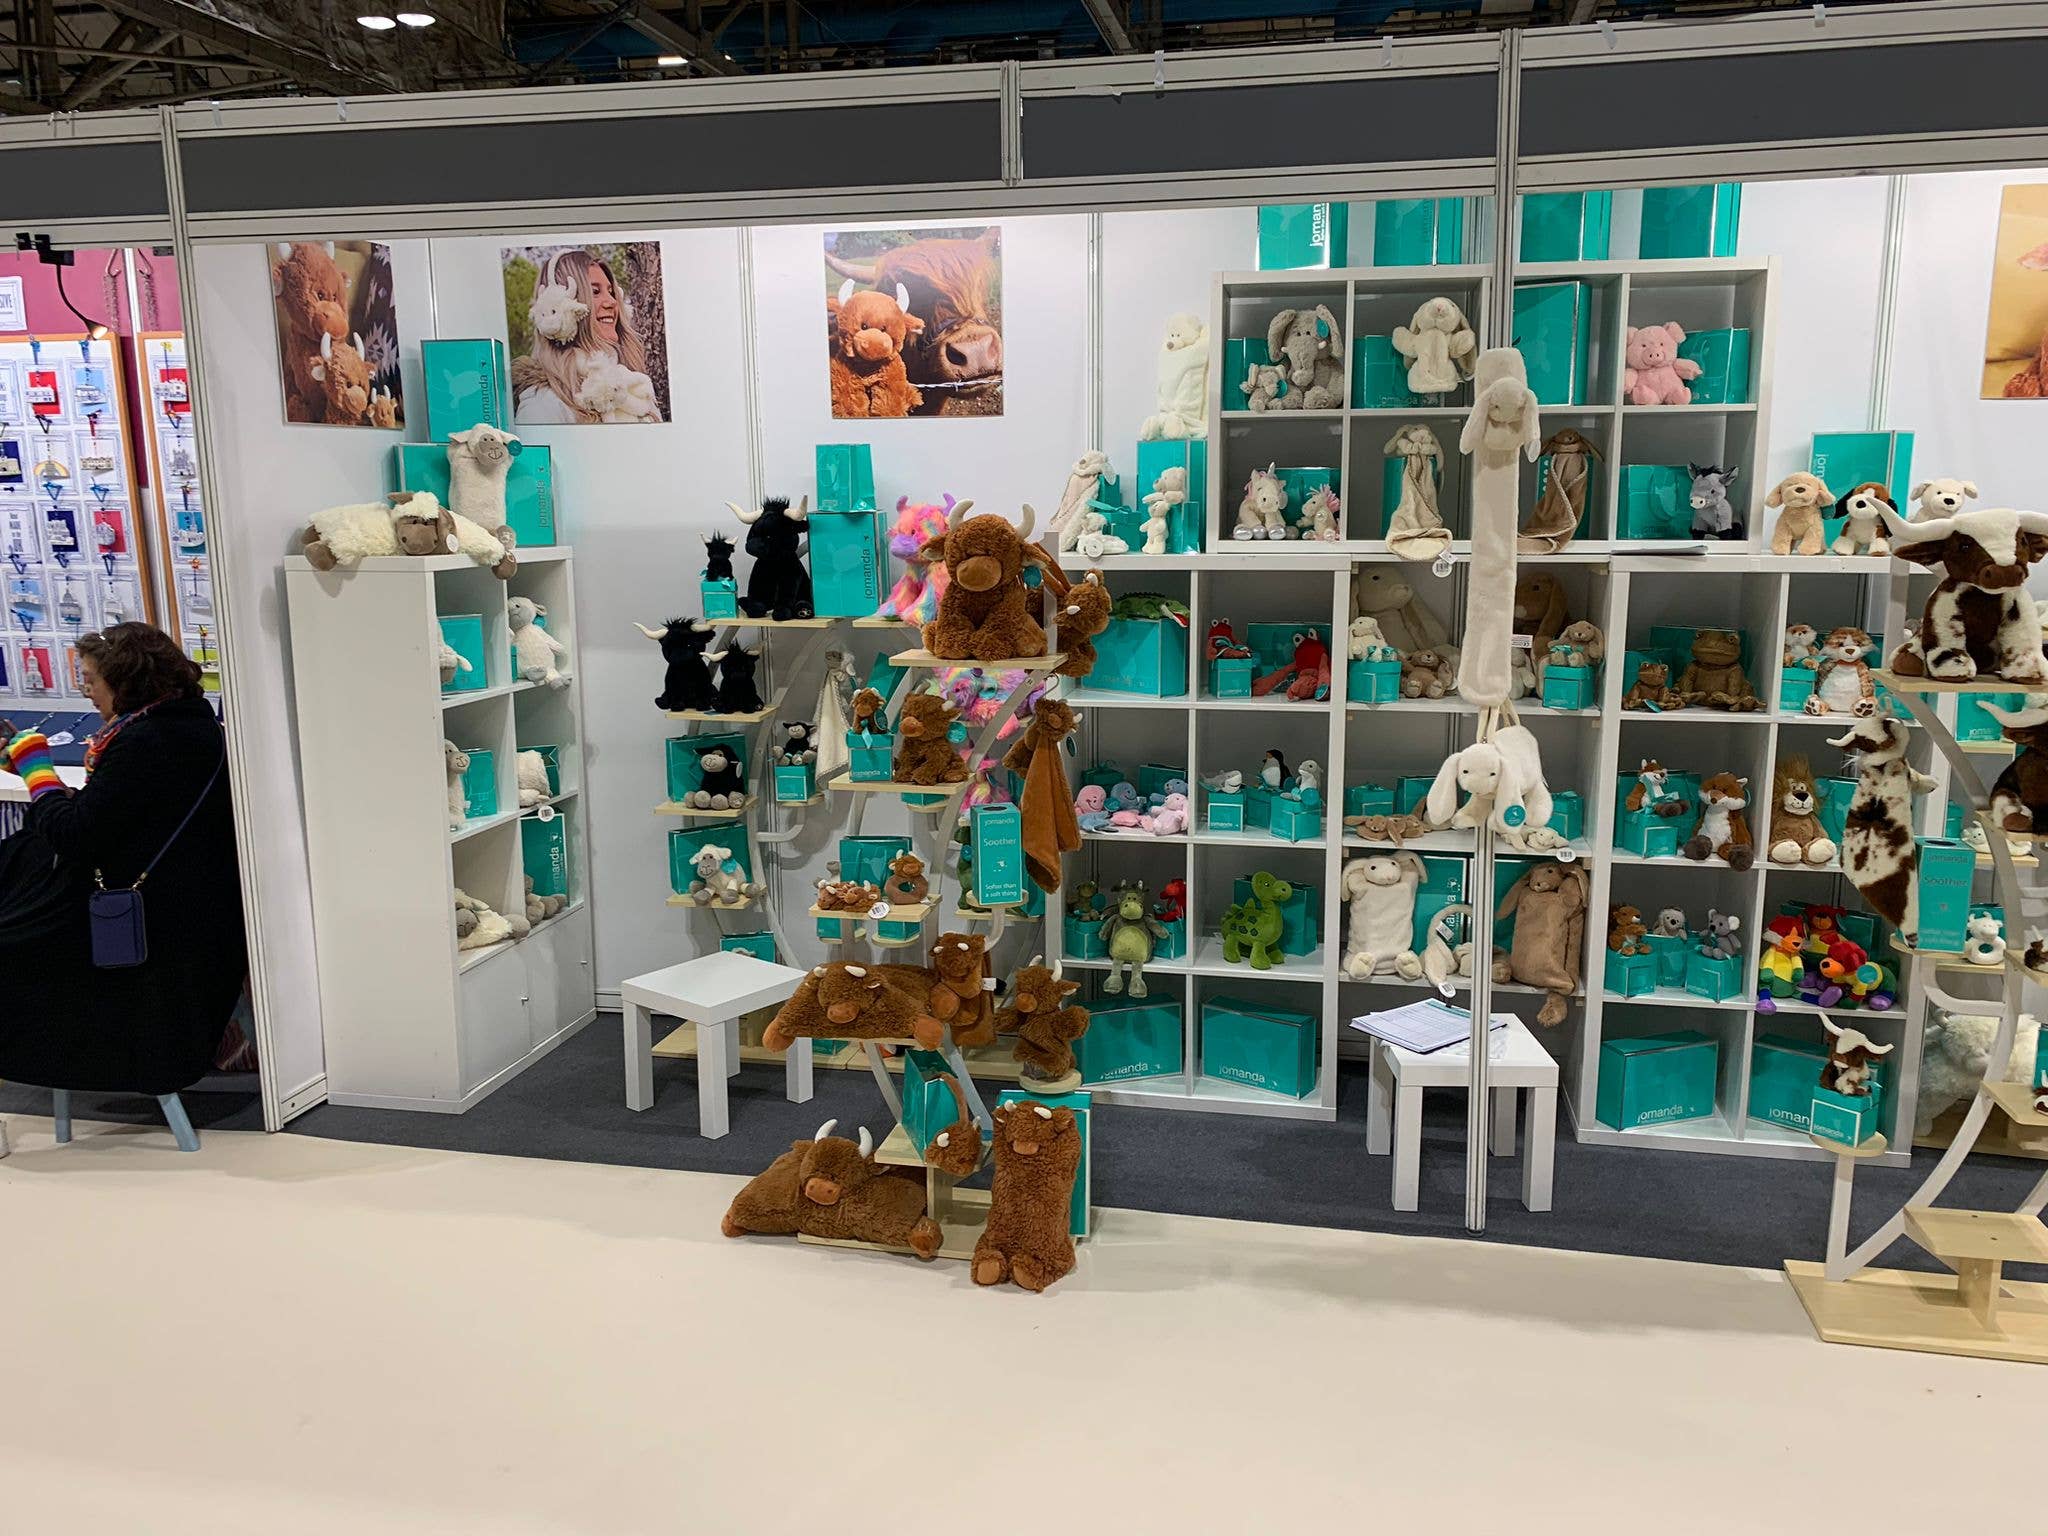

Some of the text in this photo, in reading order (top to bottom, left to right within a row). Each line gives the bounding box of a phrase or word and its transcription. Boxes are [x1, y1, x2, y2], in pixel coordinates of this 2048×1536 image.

[536, 480, 550, 528] jomanda
[861, 549, 874, 599] jomanda
[983, 836, 1017, 847] Soother
[1636, 1104, 1684, 1124] jomanda
